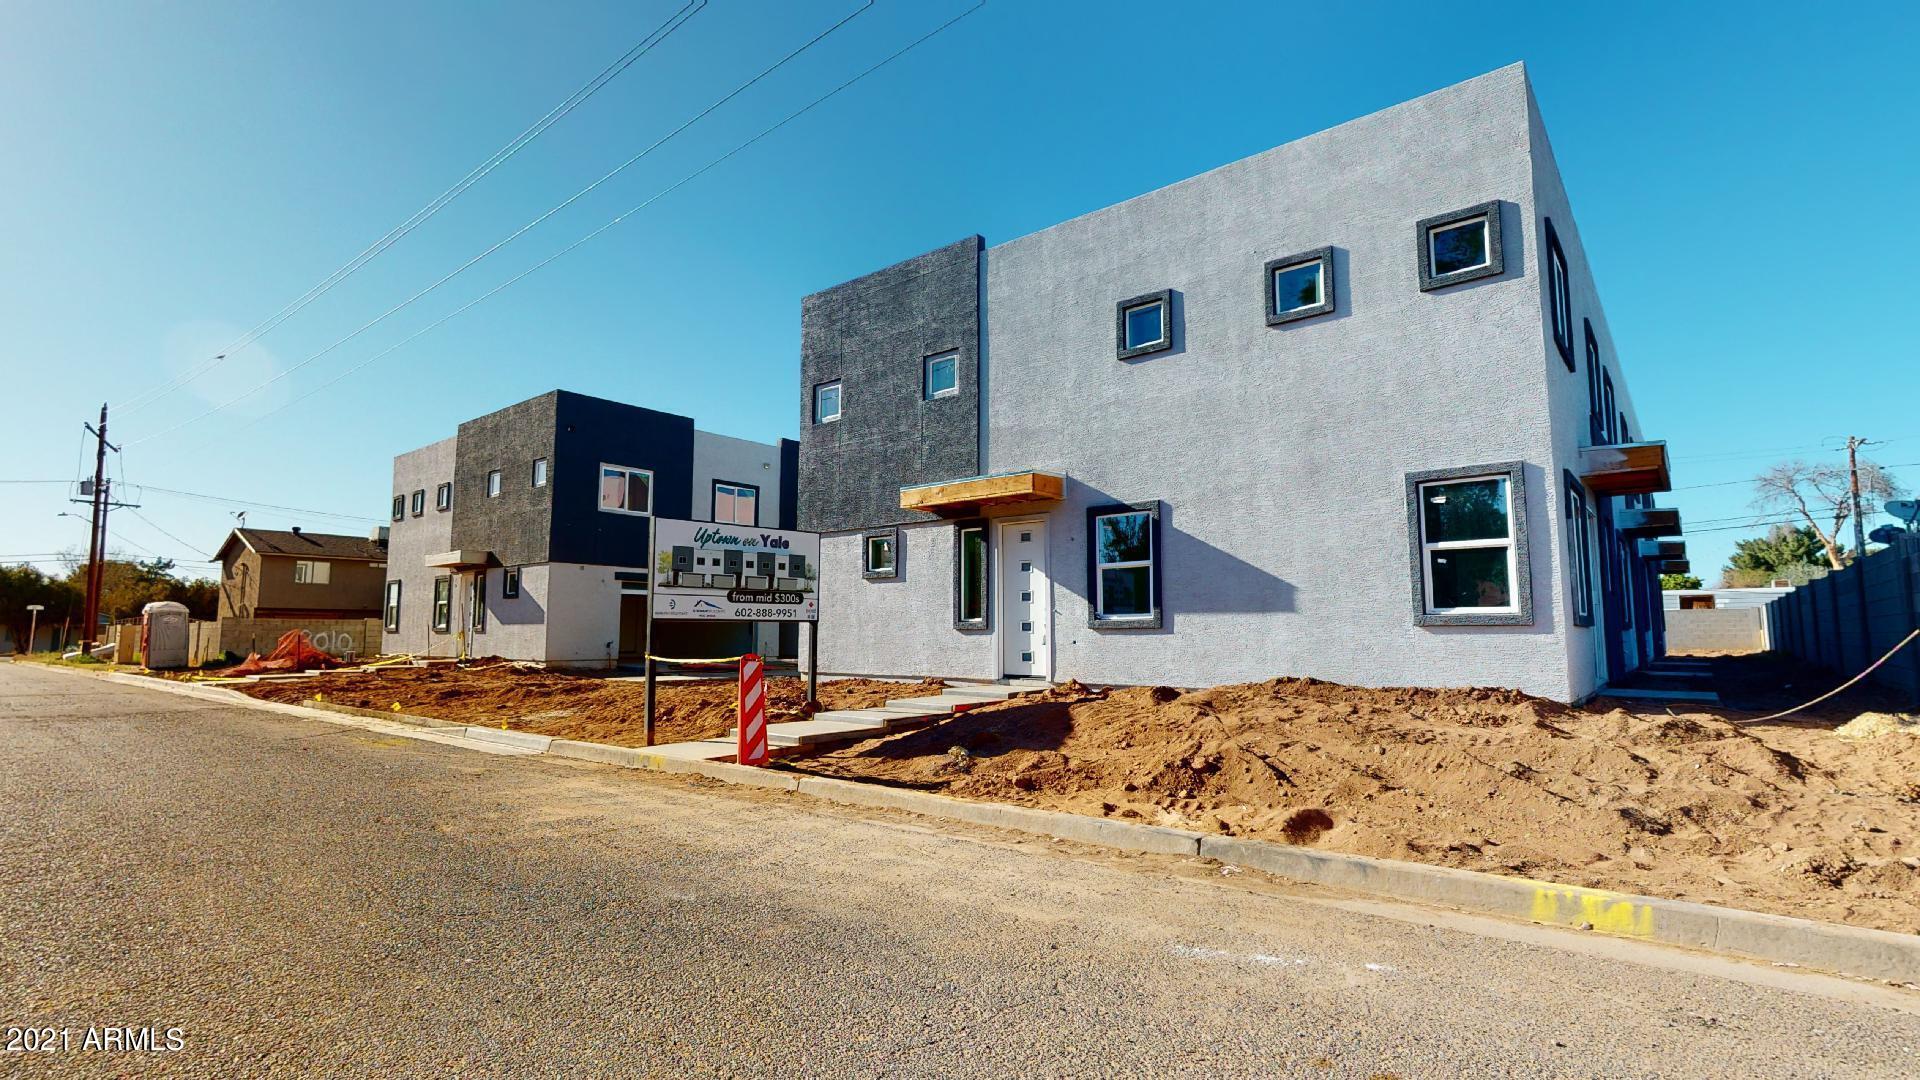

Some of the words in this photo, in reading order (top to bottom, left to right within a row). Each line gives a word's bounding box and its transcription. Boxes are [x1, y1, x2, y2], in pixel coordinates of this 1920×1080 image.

[694, 527, 741, 549] Uptown
[742, 537, 760, 547] on
[760, 534, 790, 550] Yale
[732, 592, 754, 602] from
[755, 593, 773, 603] mid
[774, 593, 800, 604] $300s
[734, 608, 797, 618] 602-888-9951
